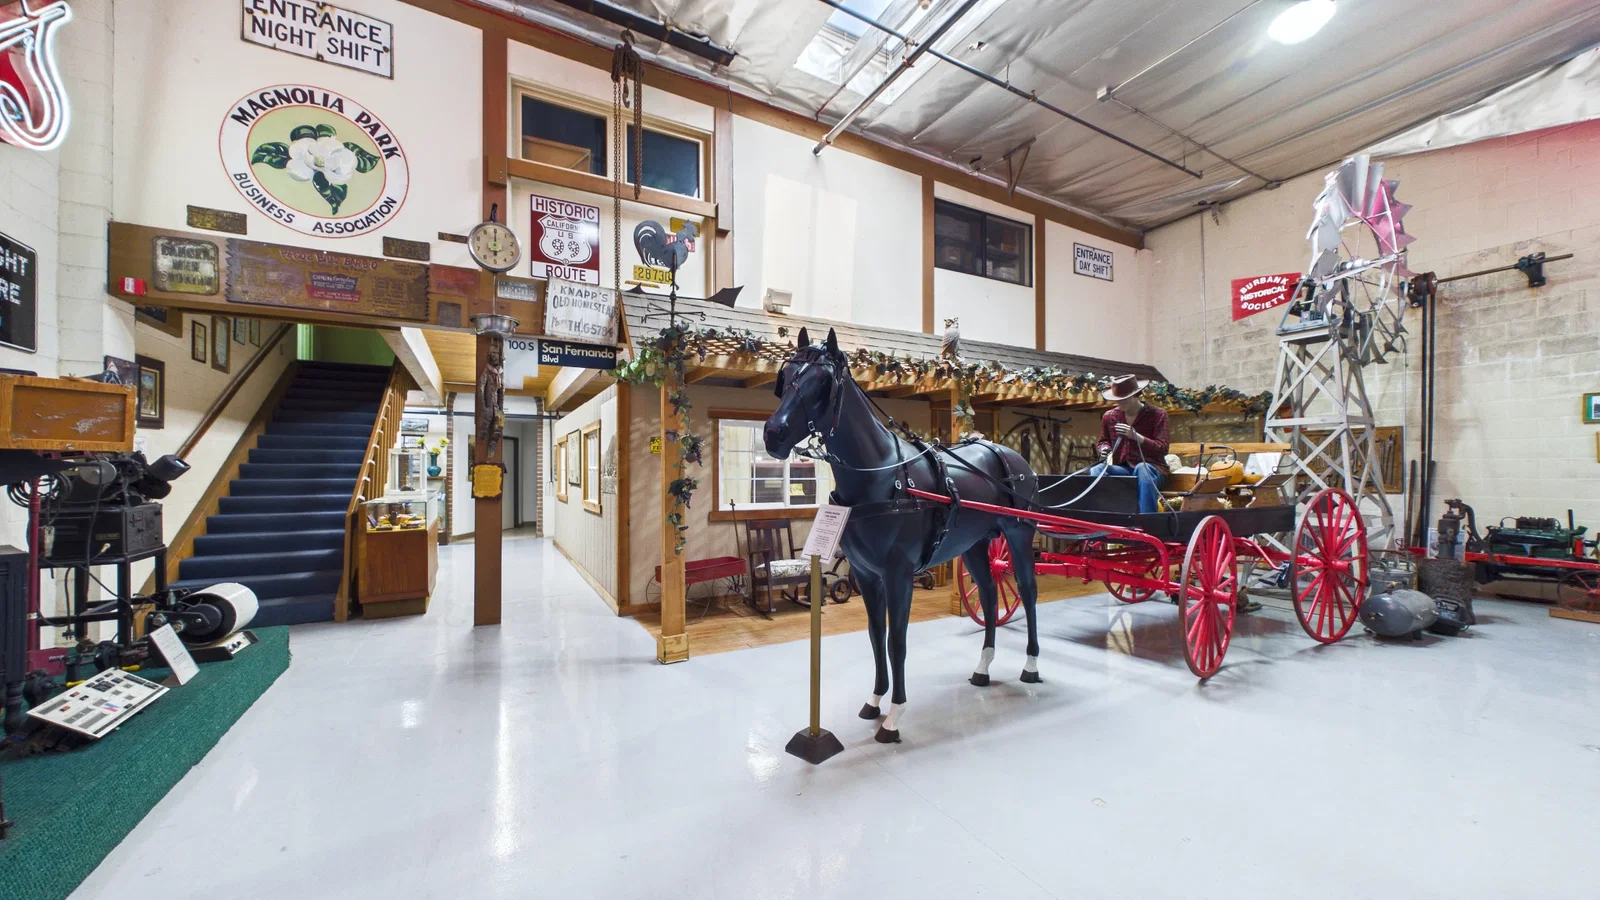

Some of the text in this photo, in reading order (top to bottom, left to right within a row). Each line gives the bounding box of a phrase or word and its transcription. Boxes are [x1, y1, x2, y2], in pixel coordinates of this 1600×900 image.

[252, 0, 382, 45] ENTRANCE
[251, 14, 384, 67] NIGHT SHIFT
[231, 87, 401, 160] MAGNOLIA PARK
[233, 172, 296, 224] BUSINESS
[312, 196, 397, 234] ASSOCIATION
[535, 197, 595, 220] HISTORIC
[546, 219, 581, 231] CALIFORN
[551, 238, 580, 258] 99
[1076, 247, 1111, 265] ENTRANCE
[545, 264, 586, 281] ROUTE
[1079, 260, 1108, 276] DAY SHIFT
[1239, 275, 1290, 294] BURBANK
[1240, 285, 1288, 301] HISTORICAL
[552, 294, 570, 309] OLD
[560, 285, 609, 303] KNAPP'S
[1241, 293, 1286, 310] SOCIETY
[508, 340, 535, 351] 100 S
[541, 342, 614, 359] San Fernando
[541, 354, 559, 364] Blvd
